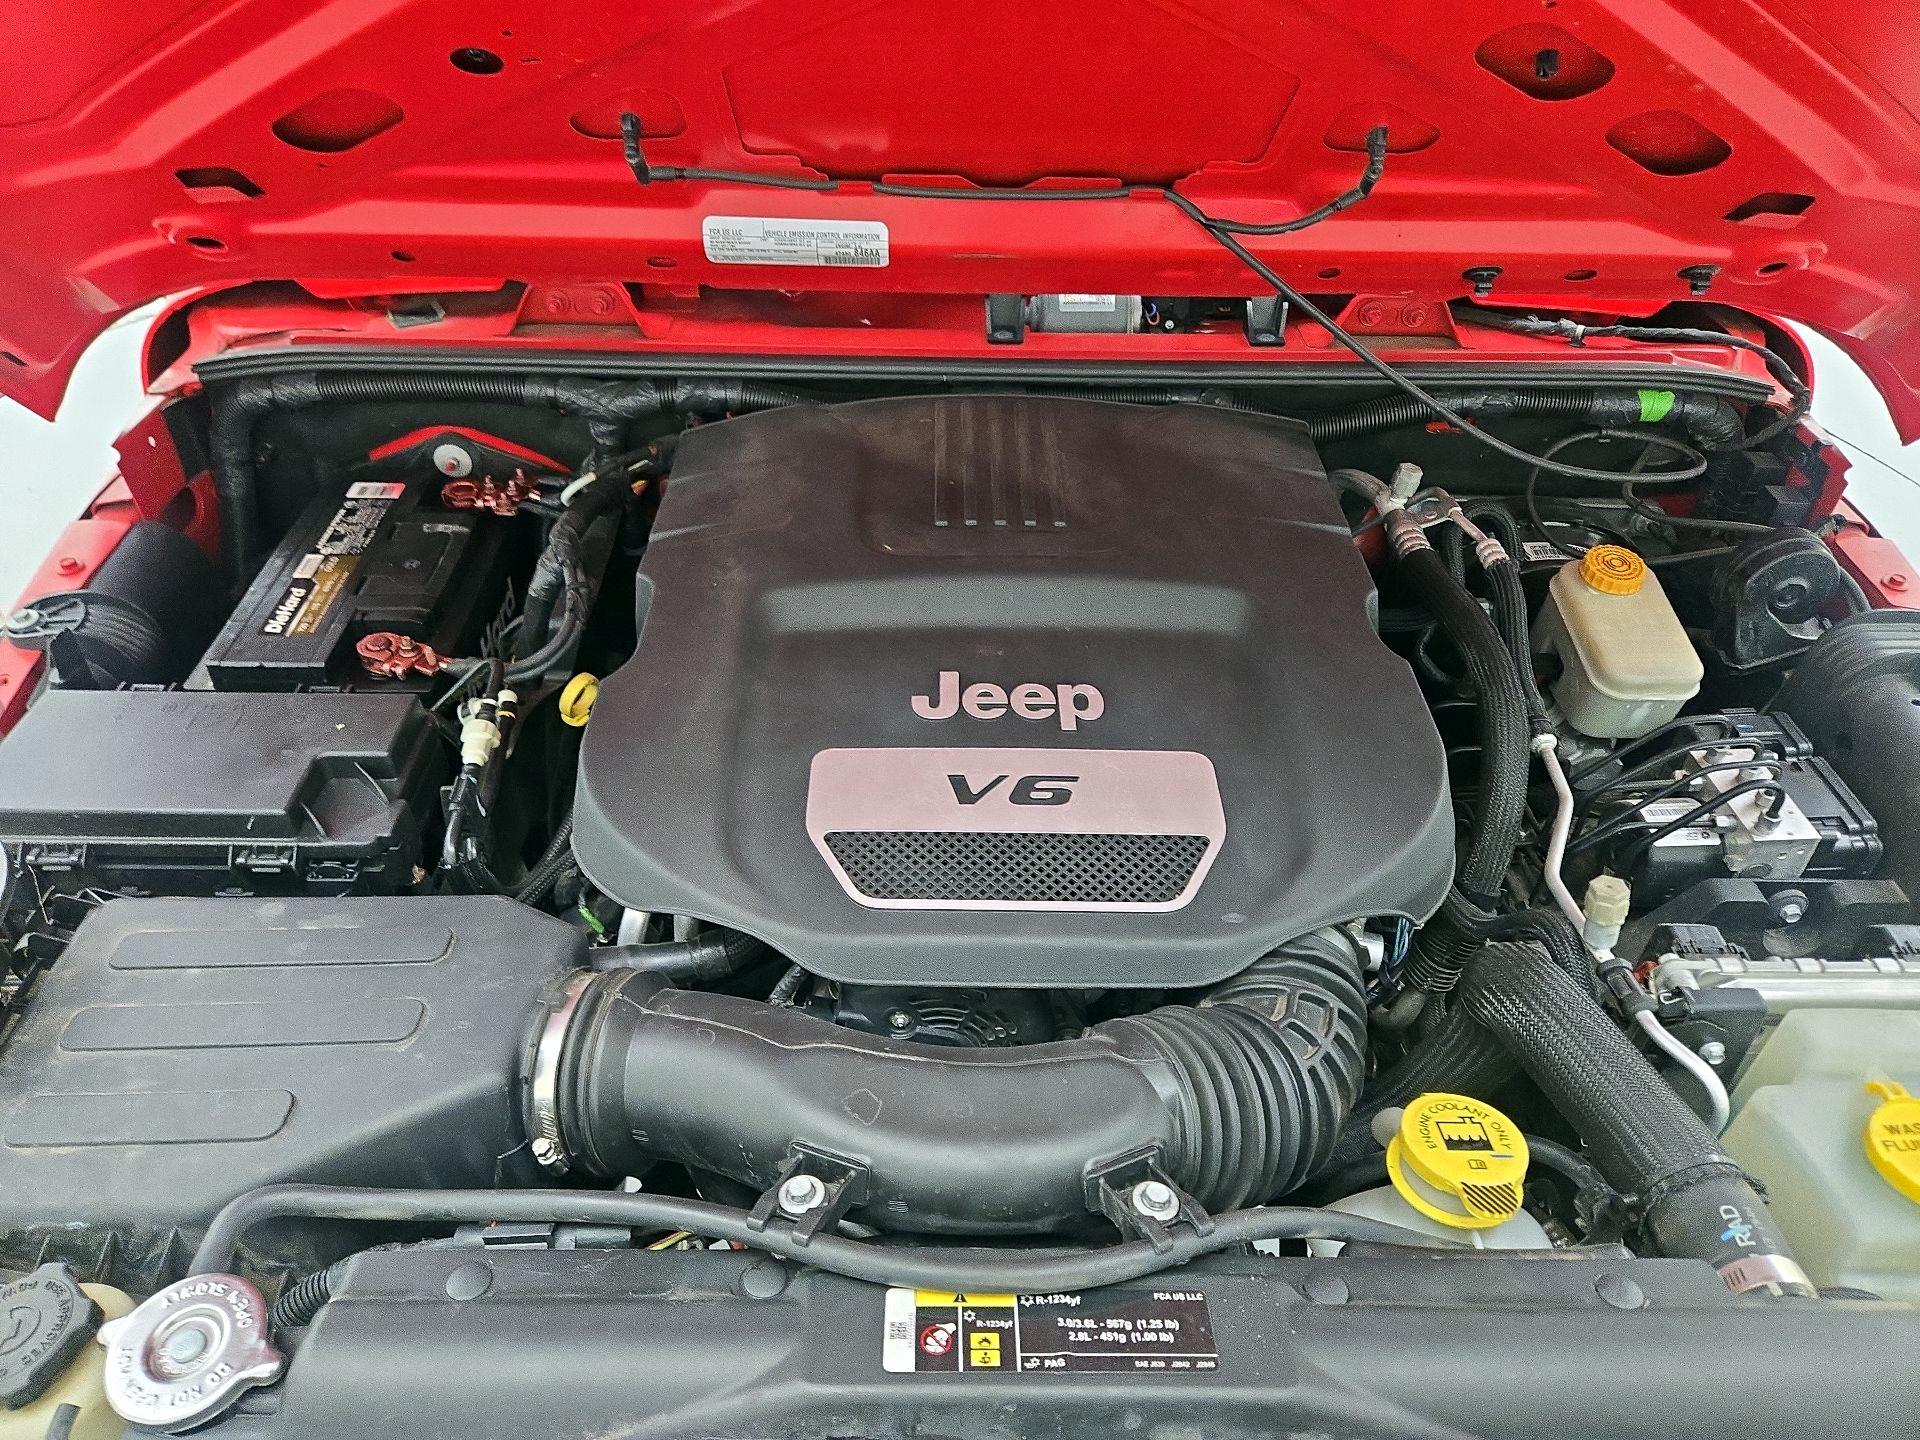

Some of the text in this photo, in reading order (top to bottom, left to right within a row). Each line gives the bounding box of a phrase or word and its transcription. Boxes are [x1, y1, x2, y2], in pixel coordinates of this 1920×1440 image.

[765, 229, 881, 241] VEHICLE EMISSION CONTROL INFORMATION
[264, 587, 307, 634] DieHard
[911, 671, 1105, 731] Jeep
[947, 774, 1080, 805] V6
[1418, 1102, 1512, 1150] ENGINE COOLANT ONLY
[1036, 1295, 1081, 1307] R-1234yf
[1153, 1292, 1173, 1300] FCA
[1186, 1293, 1204, 1301] LLC
[976, 1319, 1013, 1329] R-1234yf
[1099, 1332, 1126, 1344] 451g
[1044, 1358, 1066, 1368] PAG
